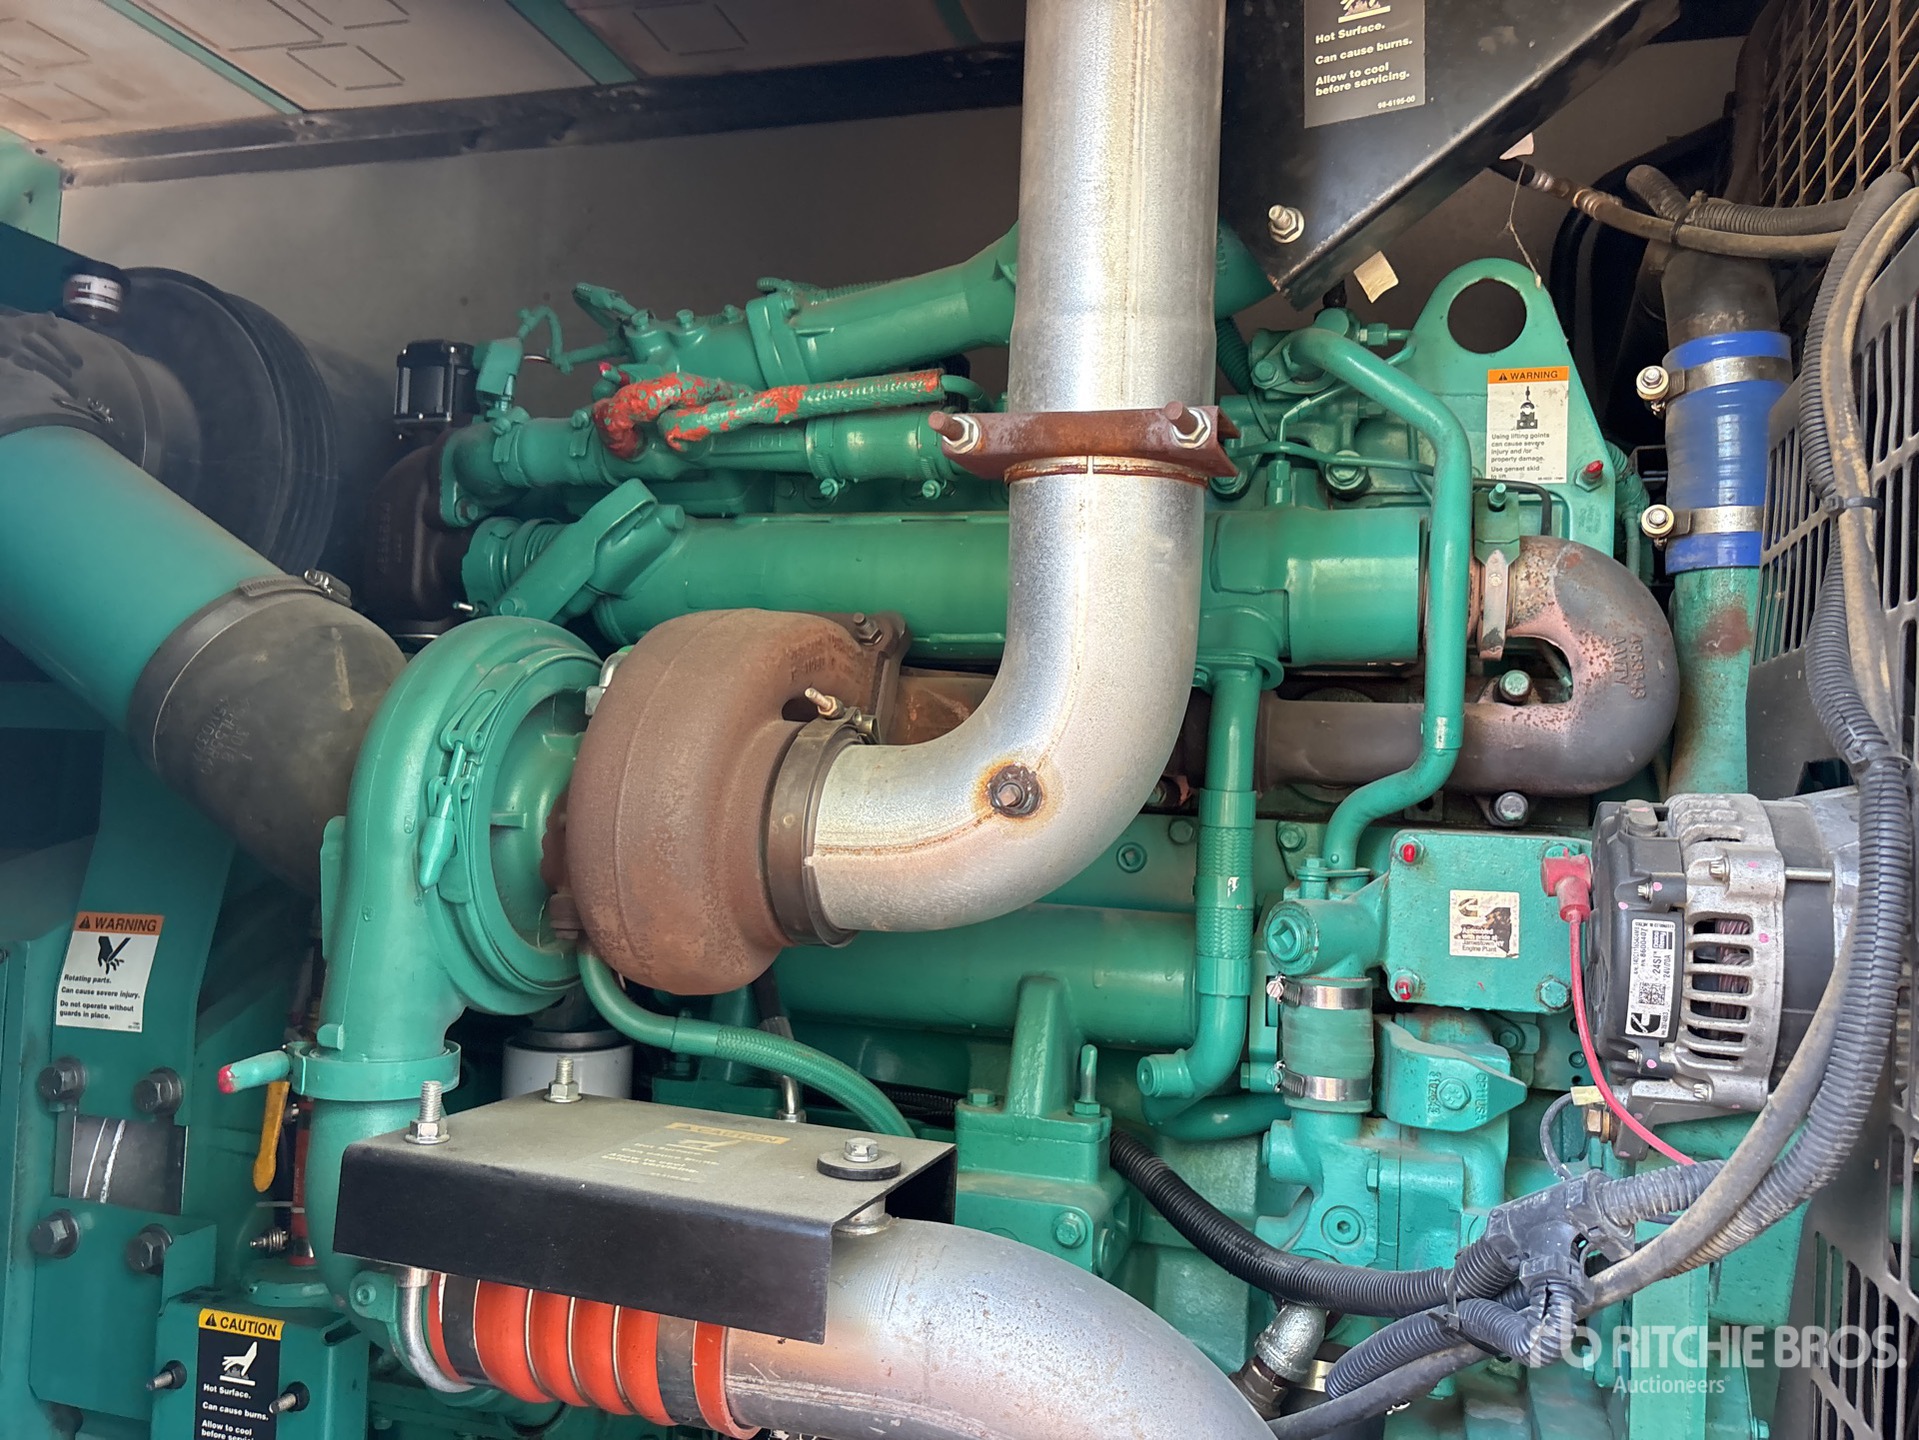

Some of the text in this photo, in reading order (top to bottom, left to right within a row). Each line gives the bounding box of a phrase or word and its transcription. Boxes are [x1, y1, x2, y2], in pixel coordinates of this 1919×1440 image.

[1315, 22, 1386, 44] Hot Surface.
[1315, 36, 1413, 65] Can cause burns.
[1315, 61, 1390, 86] Allow to cool
[1315, 70, 1410, 96] before servicing.
[1510, 370, 1558, 380] WARNING
[1530, 432, 1550, 440] points
[1518, 455, 1545, 463] damage.
[1504, 465, 1525, 473] genset
[95, 916, 158, 932] WARNING
[64, 973, 112, 984] Rotating parts.
[61, 986, 74, 994] Can
[96, 989, 118, 997] severe
[119, 990, 140, 999] injury.
[59, 1010, 82, 1018] guards
[90, 1012, 111, 1020] place.
[82, 1002, 108, 1011] operate
[109, 1004, 134, 1012] without
[697, 1125, 780, 1143] CAUTION
[219, 1316, 278, 1337] CAUTION
[203, 1383, 252, 1399] Hot Surface.
[202, 1401, 269, 1421] Can cause burns.
[201, 1419, 253, 1436] Allow to cool
[201, 1428, 227, 1440] before
